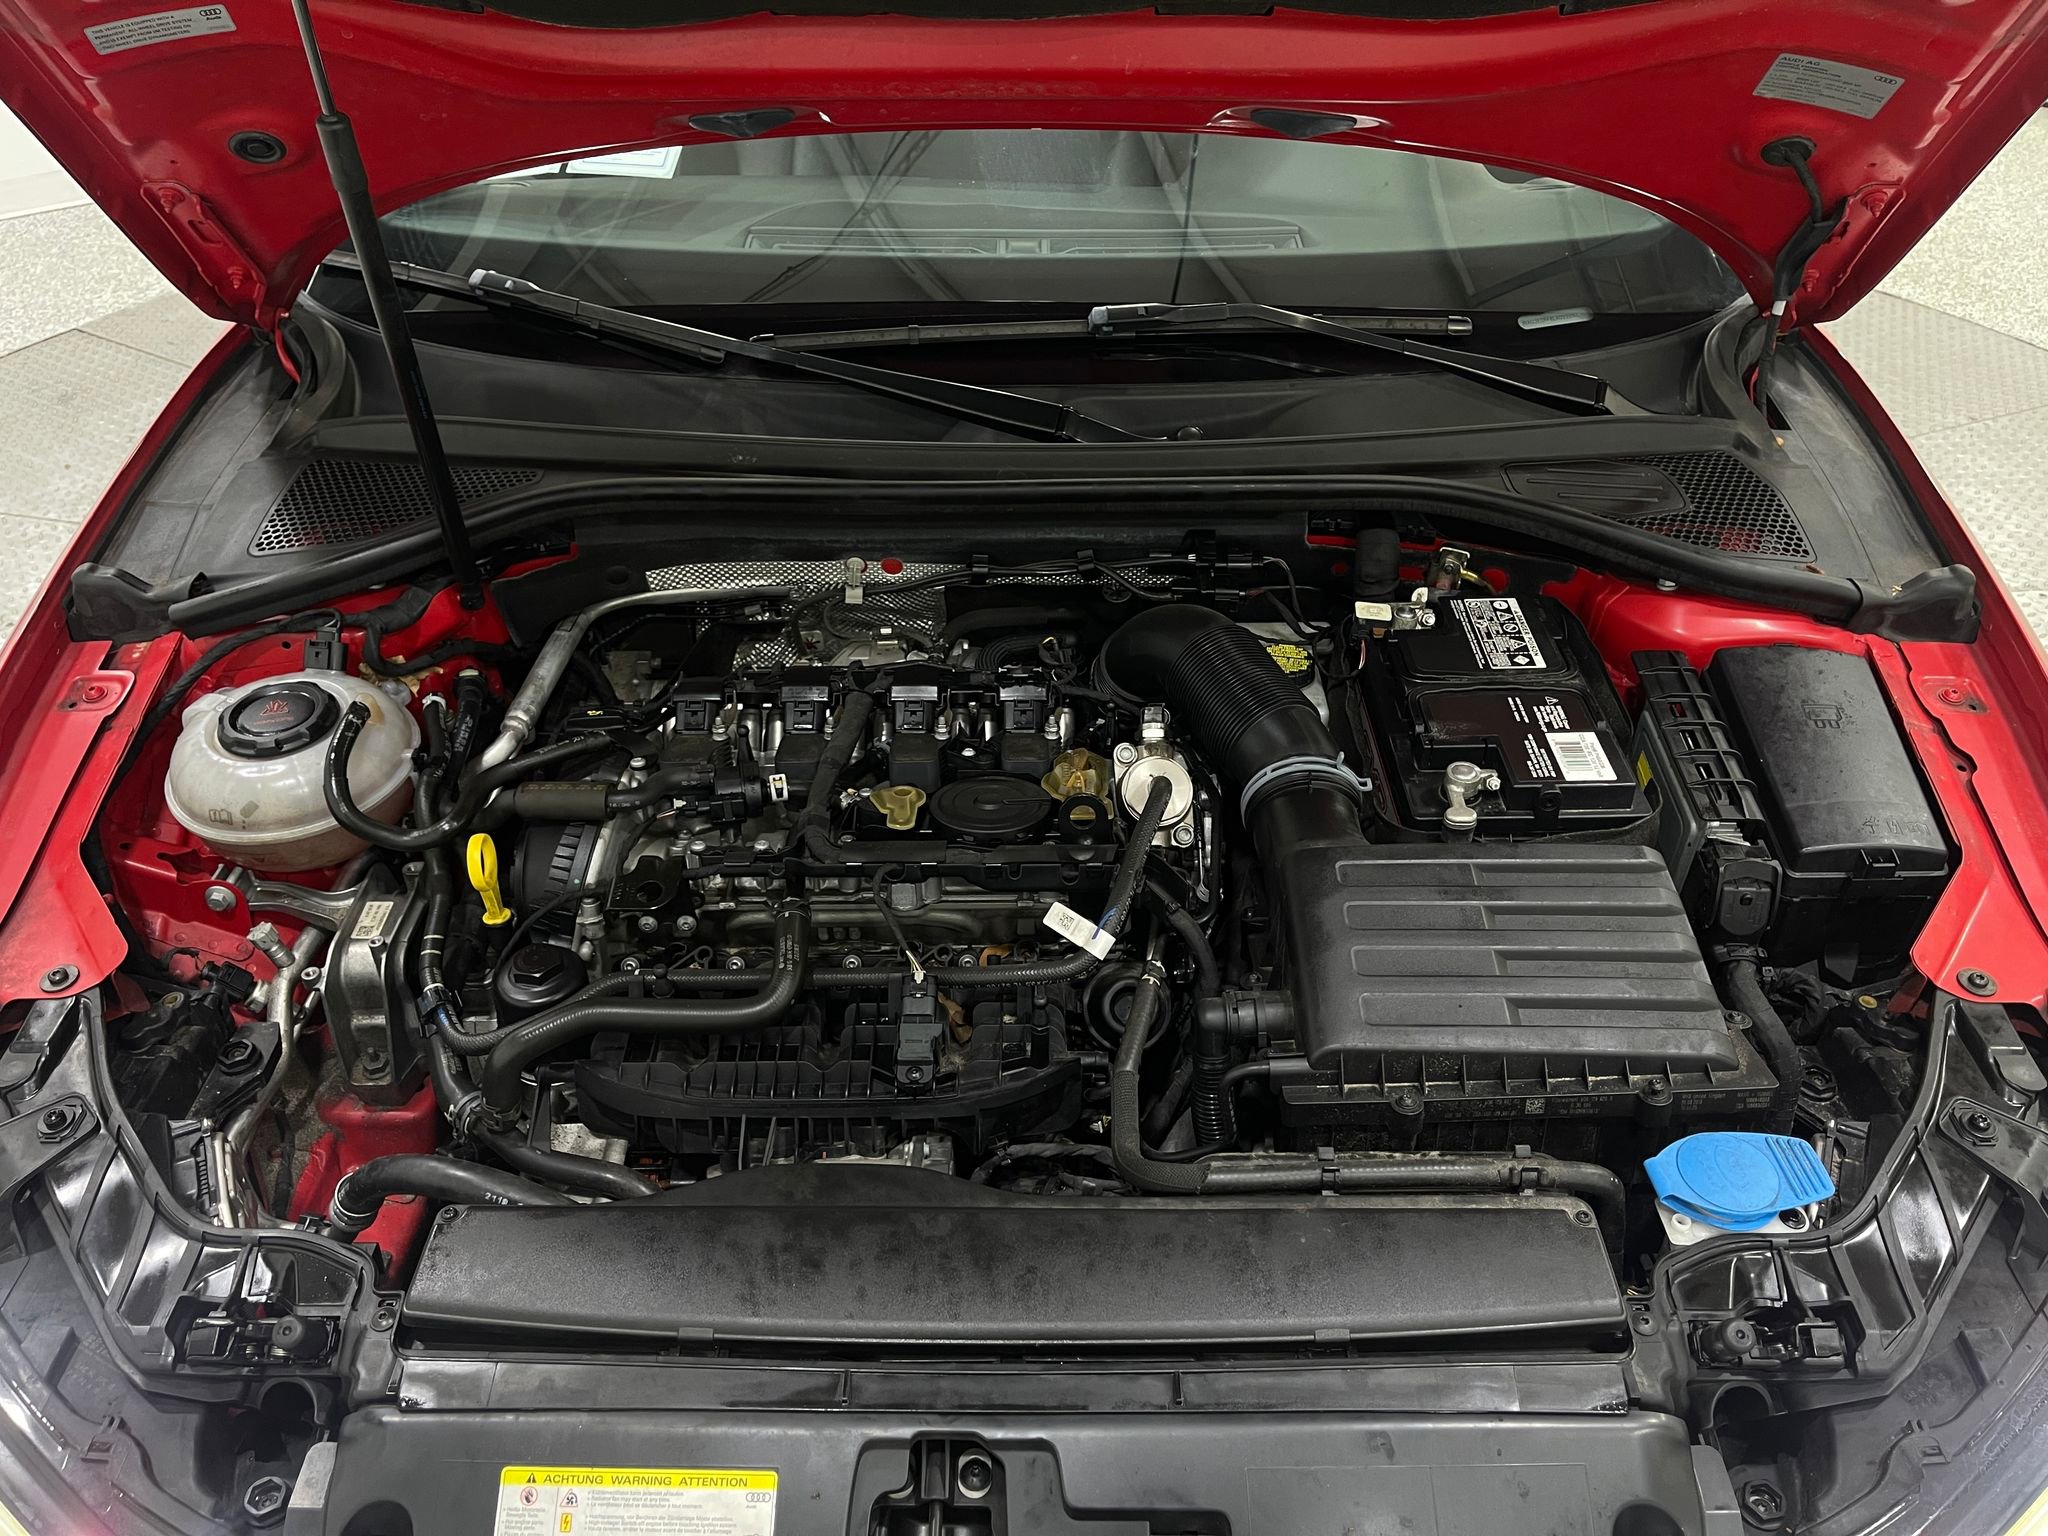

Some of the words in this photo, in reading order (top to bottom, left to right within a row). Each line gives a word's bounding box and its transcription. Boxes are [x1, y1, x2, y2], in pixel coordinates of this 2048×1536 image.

[544, 1474, 604, 1484] ACHTUNG
[611, 1475, 672, 1486] WARNING
[678, 1477, 748, 1487] ATTENTION
